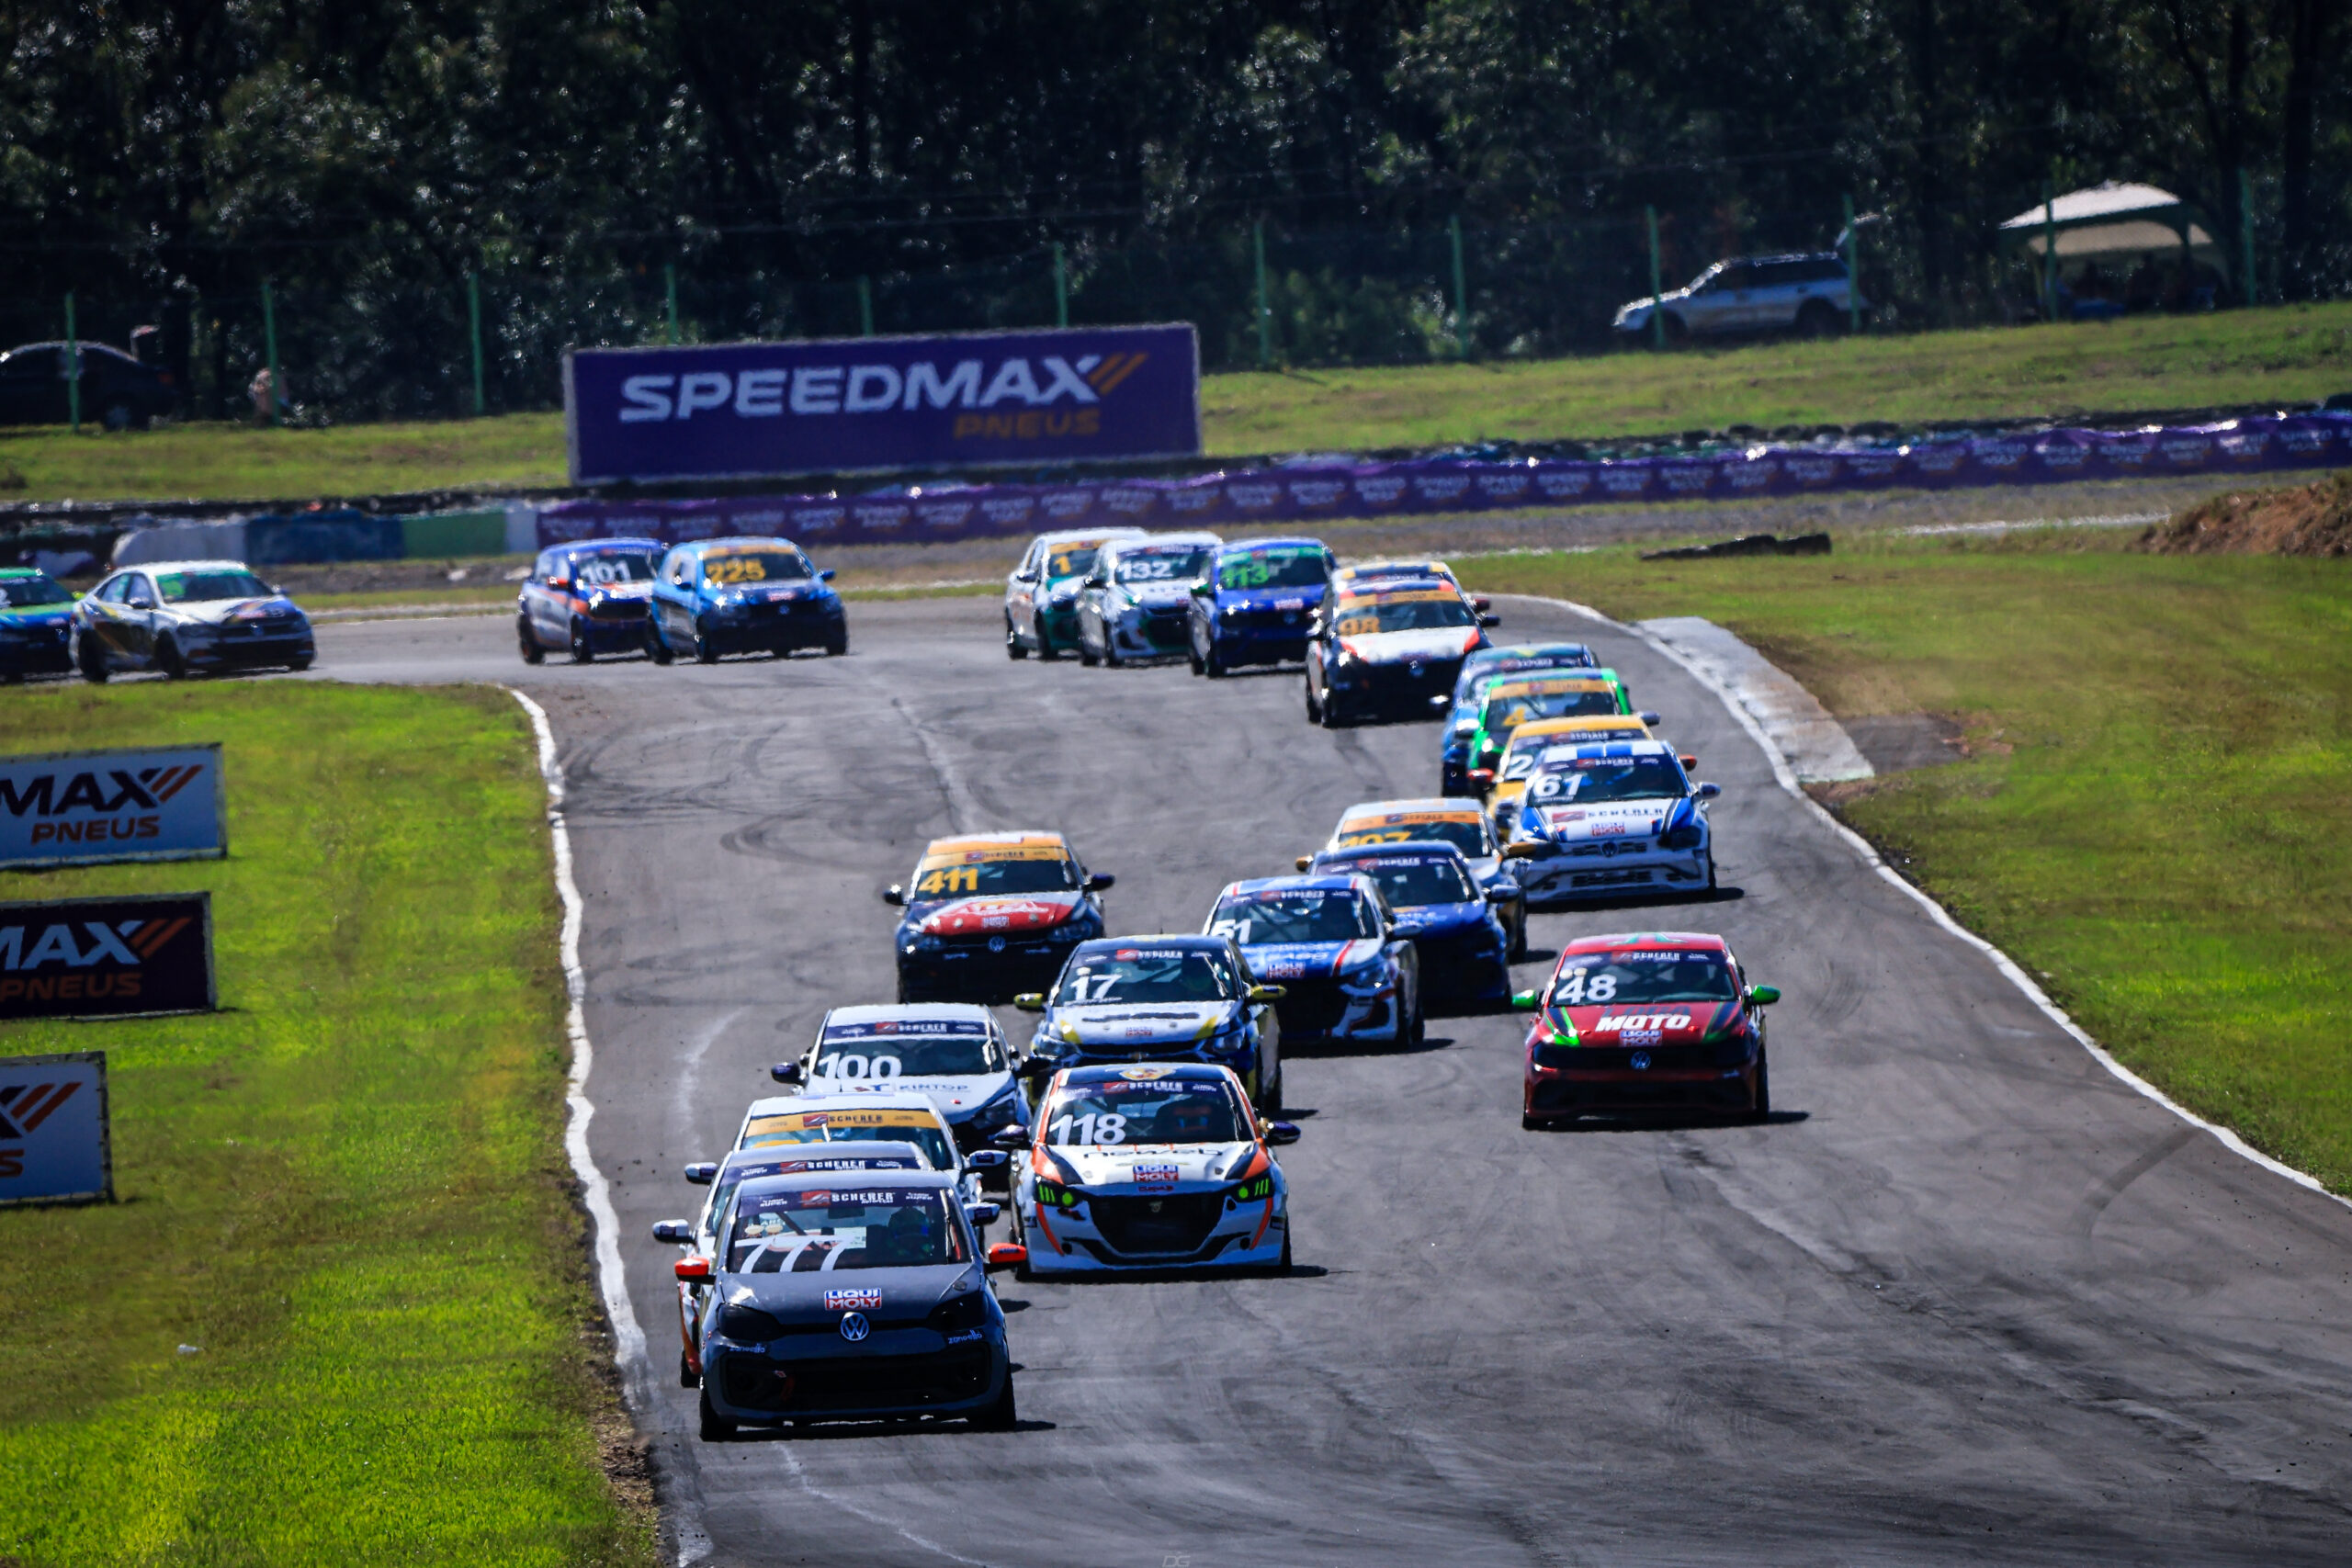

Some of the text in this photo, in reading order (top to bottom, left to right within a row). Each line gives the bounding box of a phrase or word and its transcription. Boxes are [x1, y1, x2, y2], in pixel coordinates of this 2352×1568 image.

[619, 353, 1101, 423] SPEEDMAX
[953, 408, 1102, 440] PNEUS
[581, 559, 632, 584] 101
[706, 559, 765, 584] 225
[1116, 560, 1173, 580] 132
[1533, 773, 1584, 797] 61
[30, 815, 161, 847] PNEUS
[919, 867, 978, 894] 411
[1211, 919, 1251, 944] 51
[0, 972, 143, 1002] PNEUS
[1070, 974, 1123, 1001] 17
[1555, 974, 1617, 1004] 48
[1595, 1014, 1691, 1032] MOTO
[818, 1052, 902, 1078] 100
[1049, 1112, 1127, 1145] 118
[808, 1160, 865, 1170] SCHERER
[1135, 1173, 1179, 1181] MOLY
[831, 1191, 894, 1202] SCHERER
[735, 1233, 852, 1274] 777
[827, 1290, 880, 1299] LIQUI
[827, 1299, 881, 1309] MOLY
